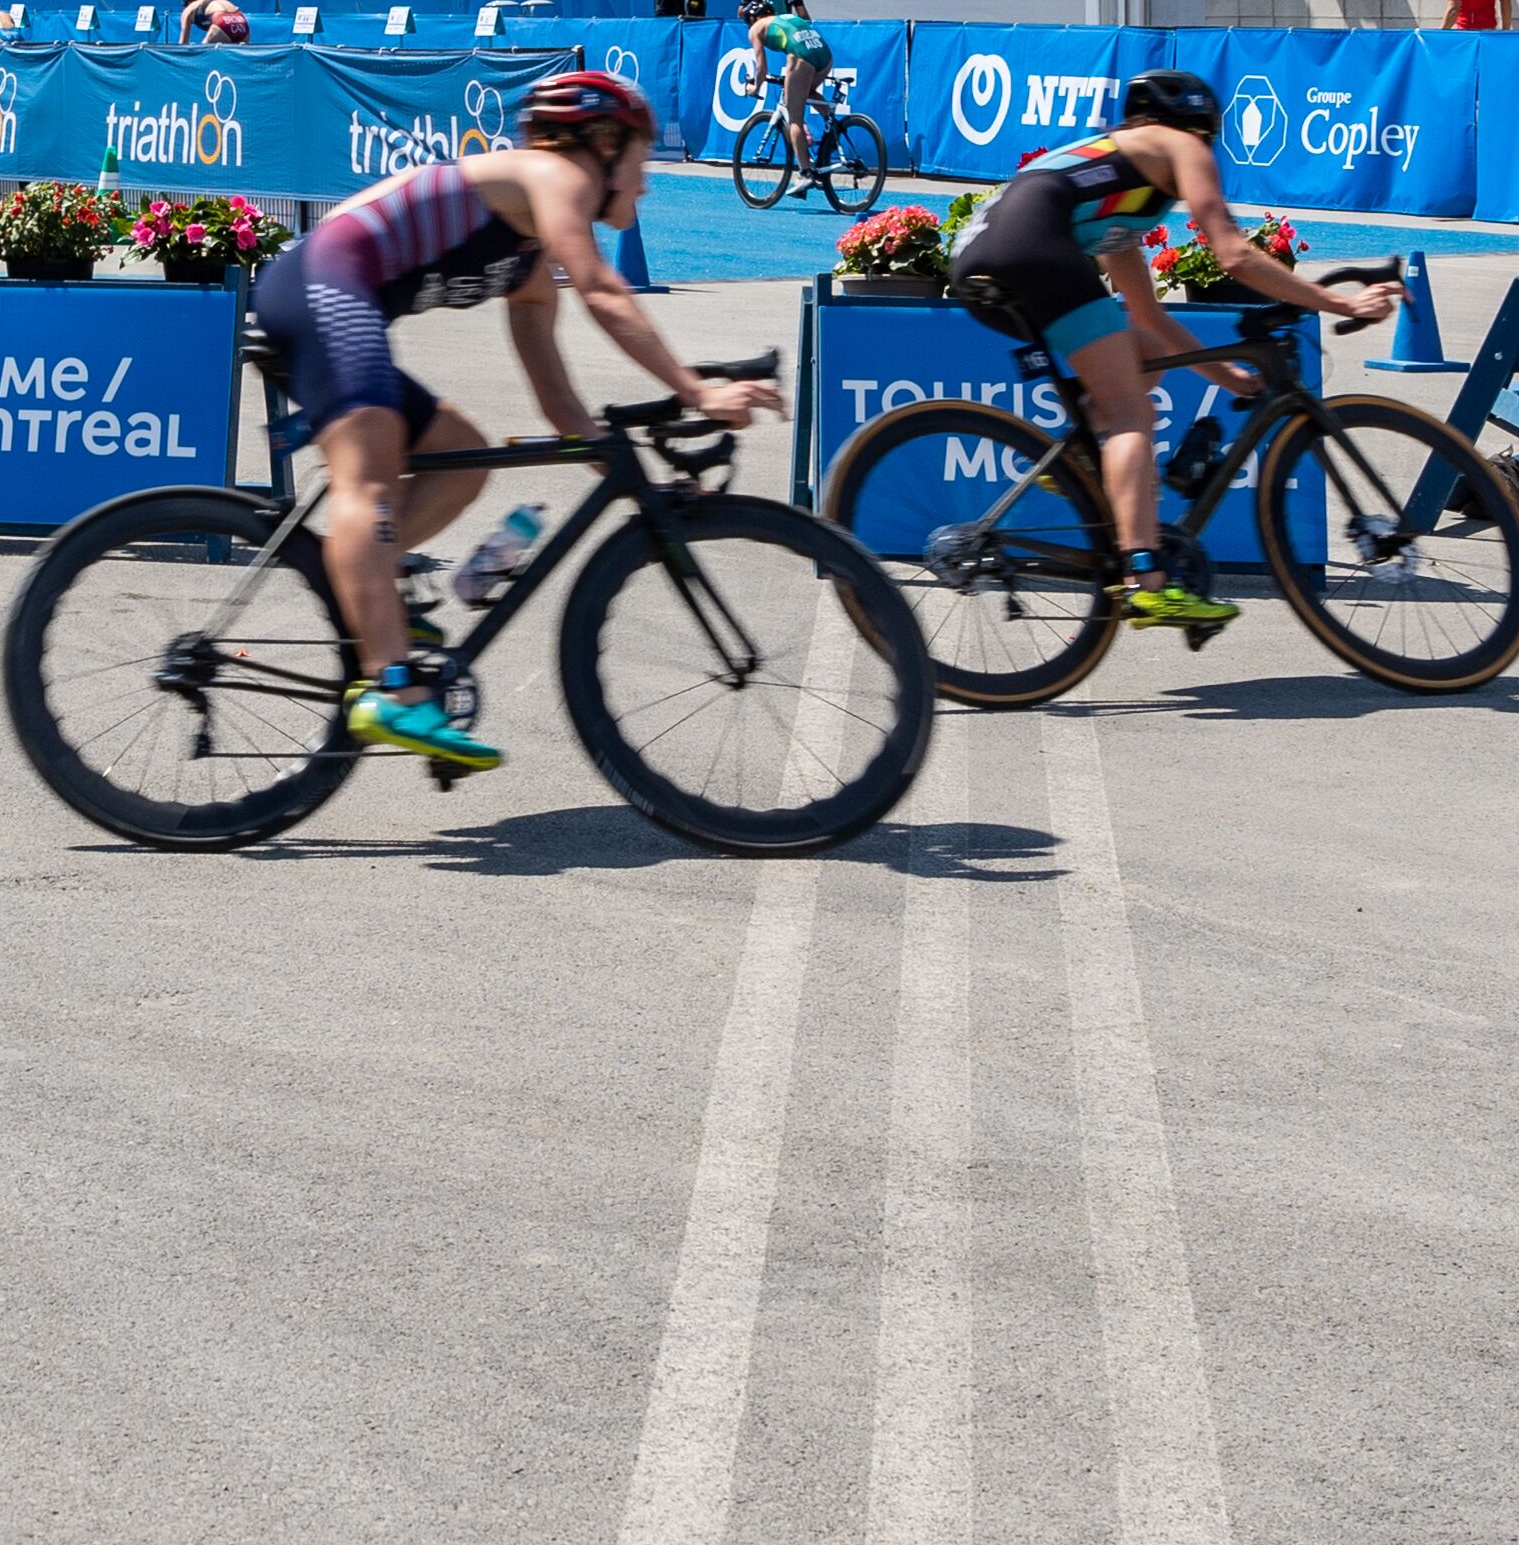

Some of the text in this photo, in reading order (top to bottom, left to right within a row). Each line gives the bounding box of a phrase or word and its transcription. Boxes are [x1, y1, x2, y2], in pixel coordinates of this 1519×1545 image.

[1021, 75, 1120, 127] NTT
[1306, 87, 1352, 108] Groupe
[107, 101, 242, 167] triathlon
[1301, 106, 1420, 172] Copley
